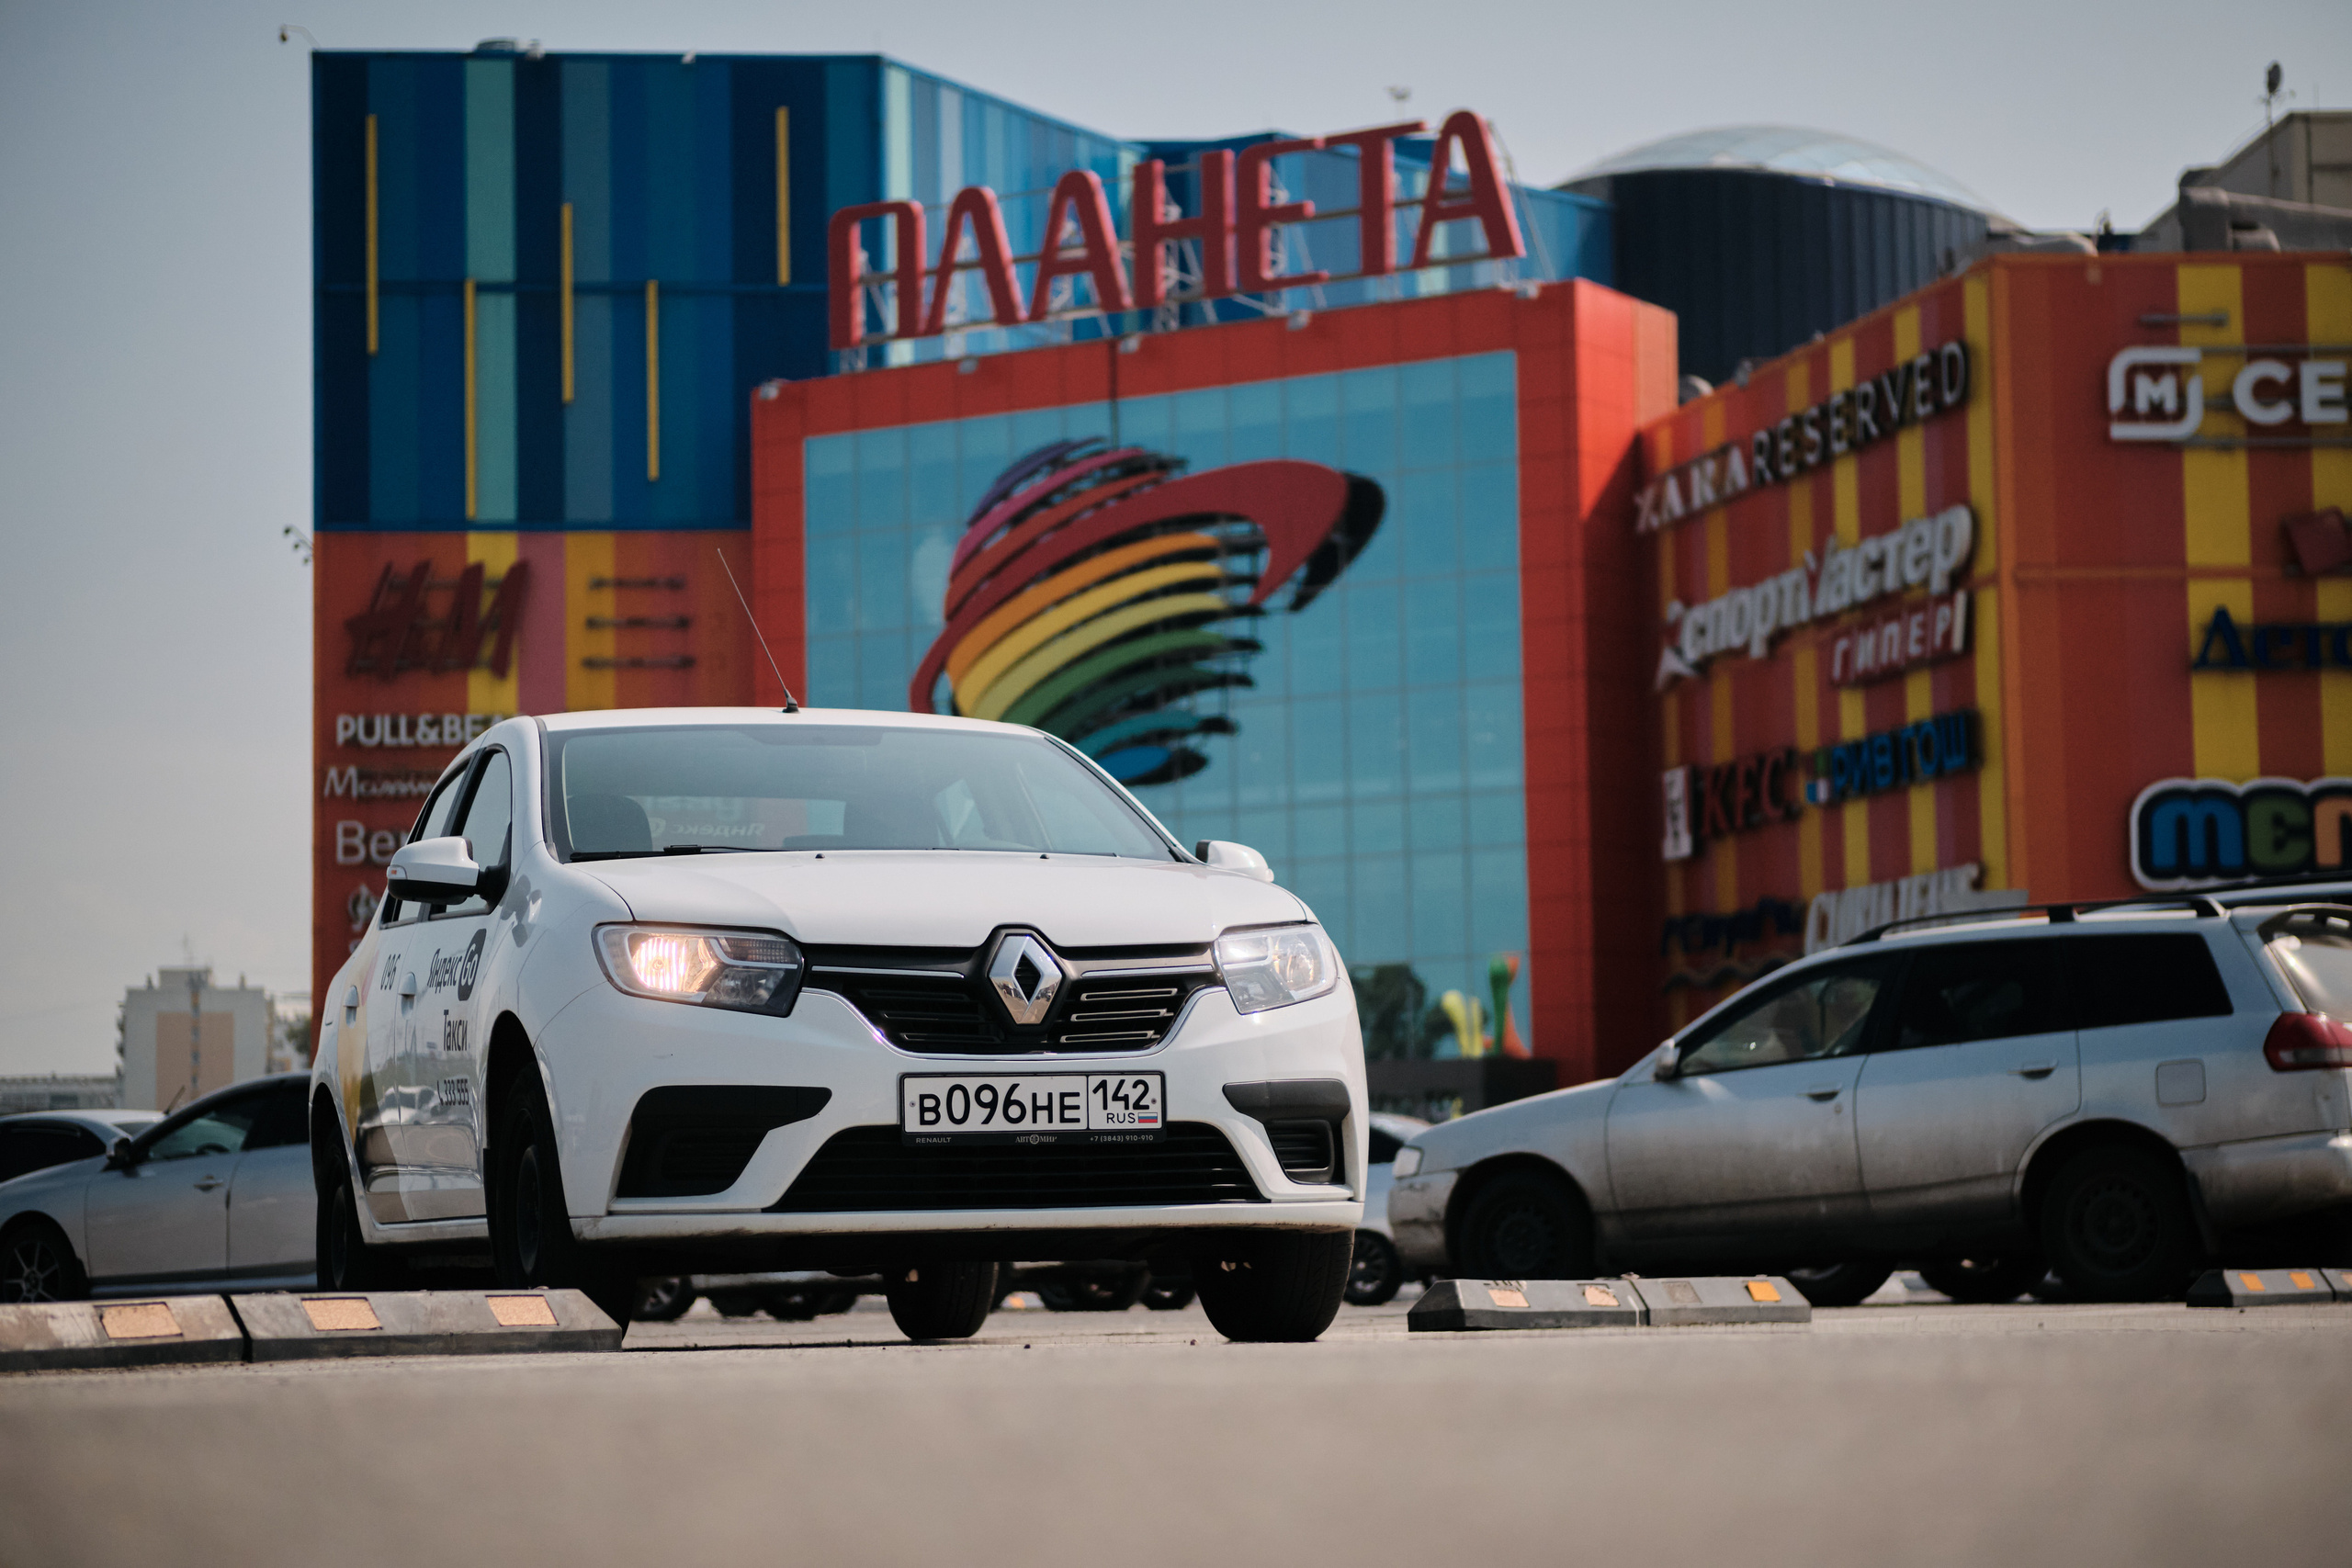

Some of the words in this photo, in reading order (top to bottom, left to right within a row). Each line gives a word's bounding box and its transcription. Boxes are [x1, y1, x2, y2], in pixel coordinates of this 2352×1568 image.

[828, 109, 1527, 351] ПЛАНЕТА
[1752, 339, 1968, 485] RESERVED
[1701, 748, 1786, 836] KFC
[380, 953, 401, 990] 096
[427, 948, 463, 994] Яндекс
[460, 943, 480, 987] Go
[444, 1010, 468, 1052] Такси
[919, 1083, 1080, 1125] В096НЕ
[1092, 1079, 1150, 1111] 142
[1107, 1112, 1136, 1124] RUS
[1100, 1134, 1124, 1143] (3843)
